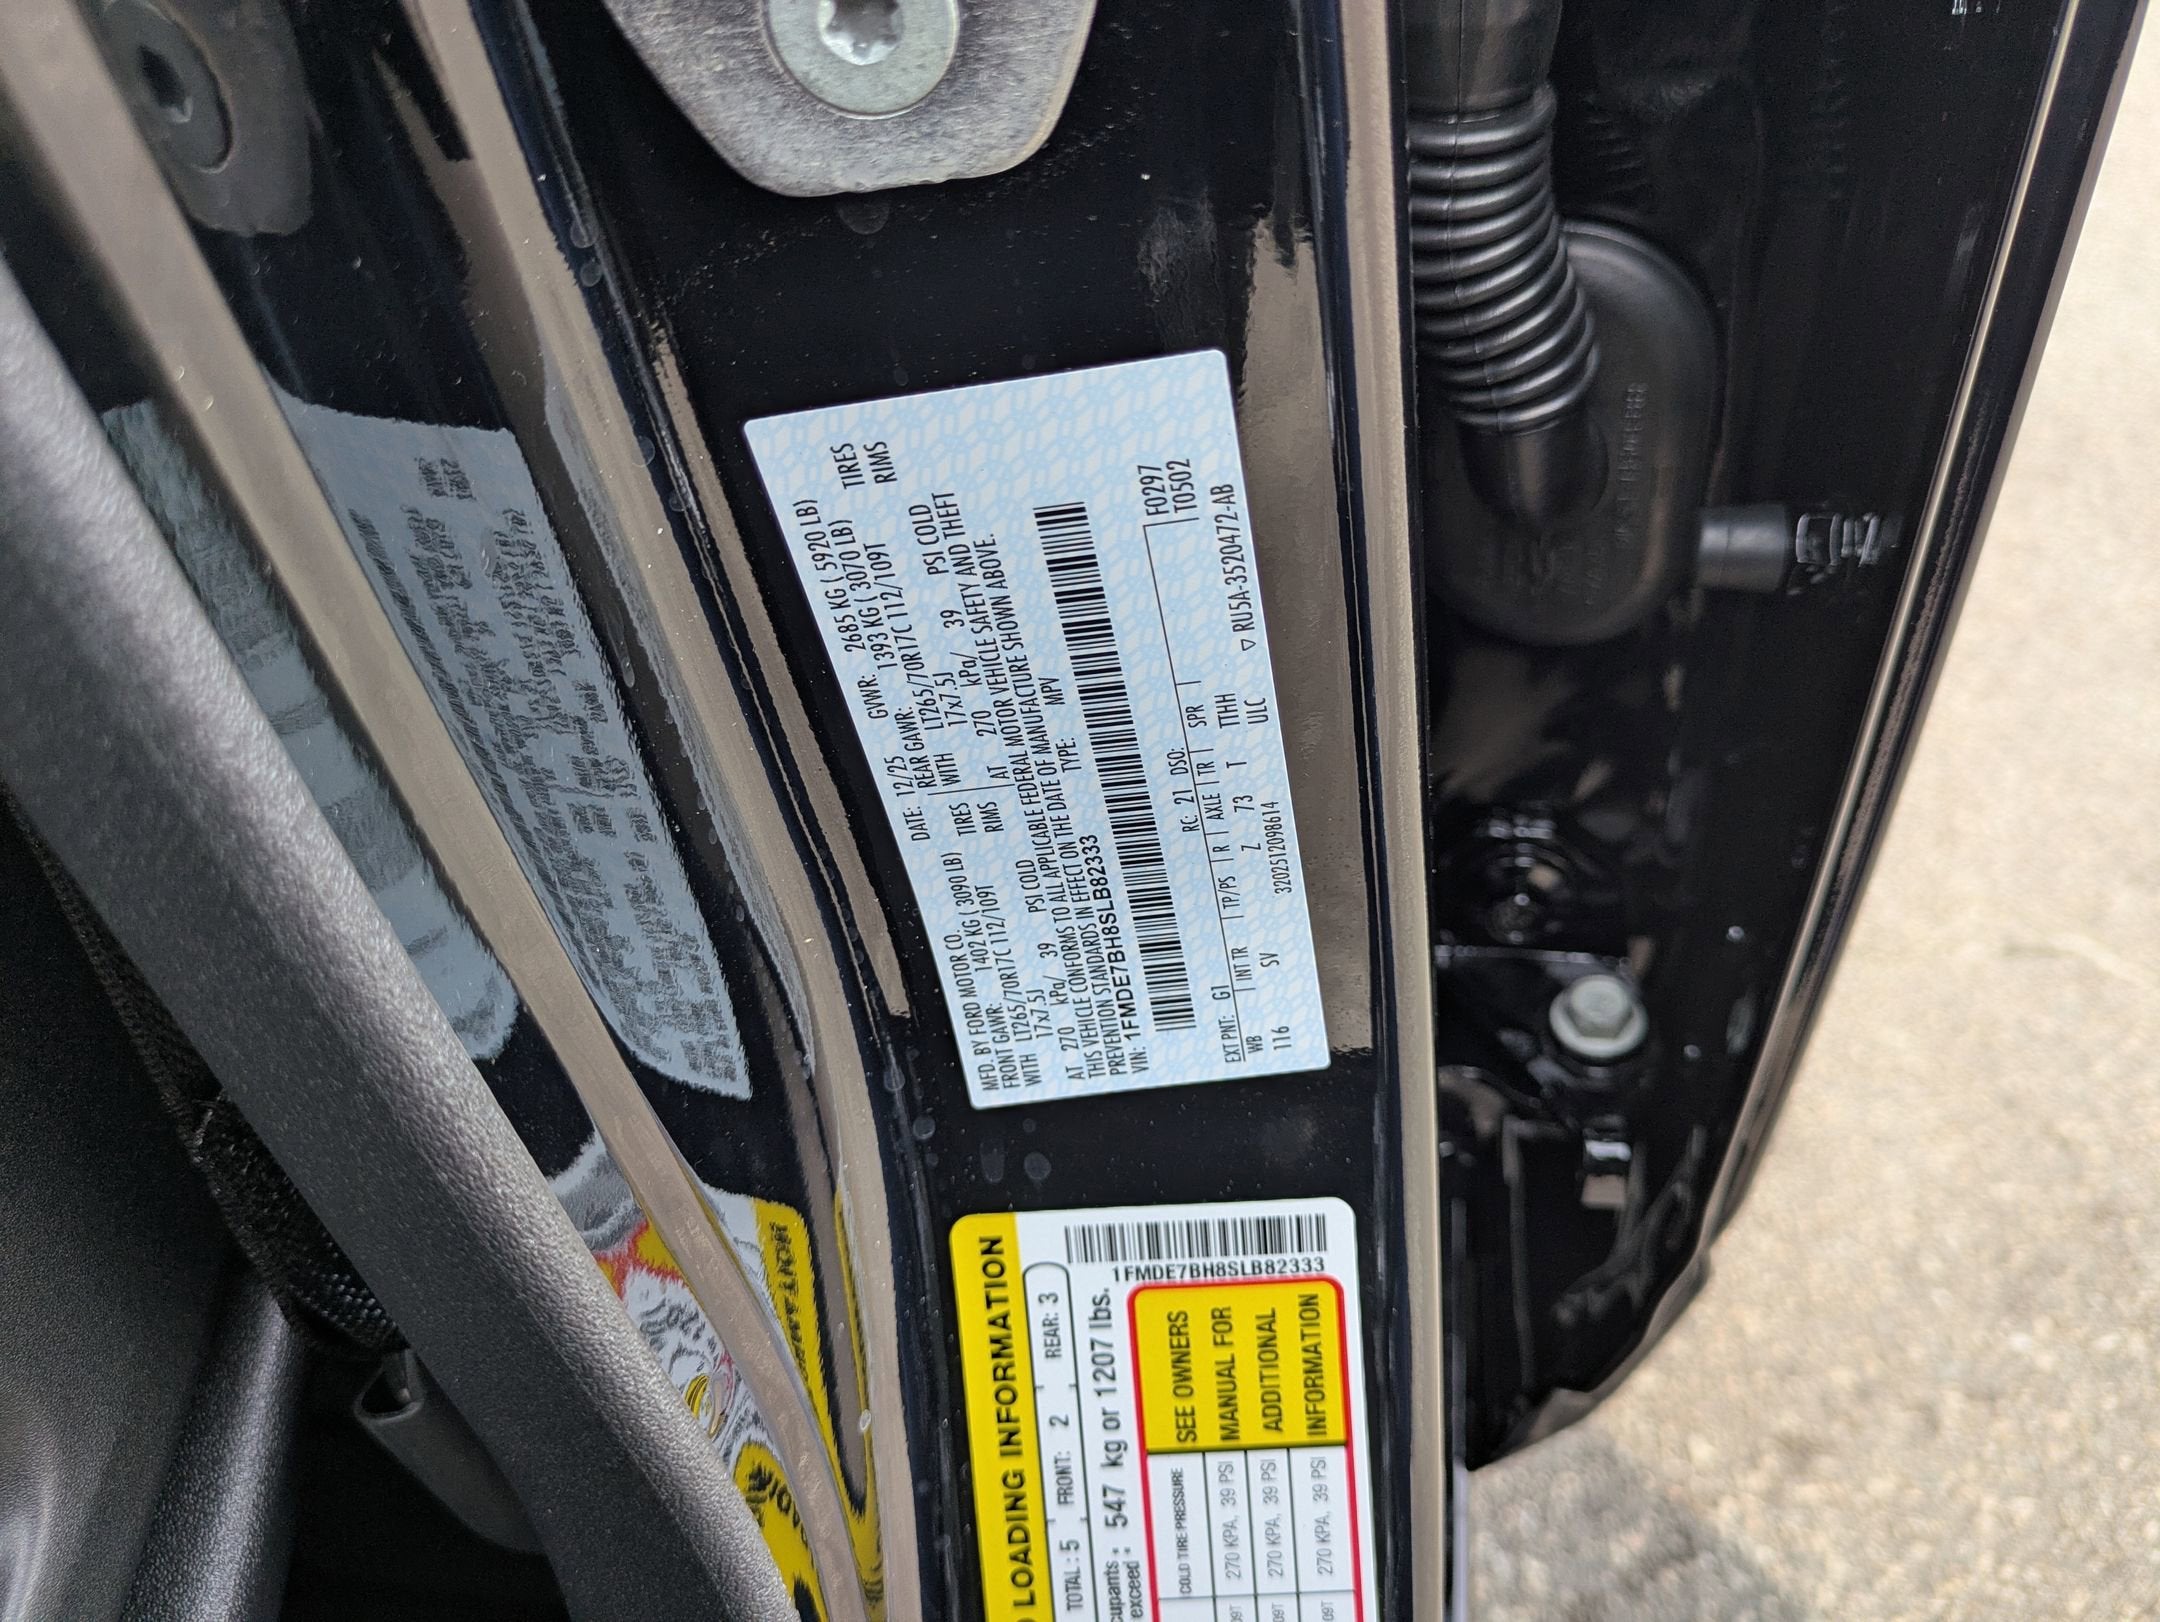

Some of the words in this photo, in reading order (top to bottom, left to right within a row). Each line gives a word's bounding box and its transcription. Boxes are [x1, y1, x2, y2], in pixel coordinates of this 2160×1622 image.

[829, 442, 866, 490] TIRES
[862, 441, 898, 484] RIMS
[1136, 464, 1170, 516] F0297
[1165, 458, 1198, 514] T0502
[792, 499, 822, 526] LB)
[907, 504, 940, 546] COLD
[930, 492, 966, 540] THEFT
[826, 519, 856, 546] LB)
[803, 530, 838, 571] 5920
[921, 550, 950, 575] PSI
[947, 543, 978, 576] AND
[972, 533, 1008, 590] ABOVE.
[1209, 483, 1255, 632] RU5A-3520472-AB
[838, 550, 872, 592] 3070
[862, 543, 908, 620] 112/109T
[824, 588, 851, 610] KG
[957, 582, 993, 634] SAFETY
[833, 613, 867, 653] 2685
[857, 606, 884, 629] KG
[939, 609, 965, 629] 39
[988, 594, 1024, 651] SHOWN
[866, 632, 898, 670] 1393
[974, 637, 1010, 696] VEHICLE
[889, 623, 945, 732] LT265/70R17C
[949, 651, 983, 687] kPa/
[856, 673, 889, 719] GVWR:
[931, 671, 968, 727] 17x7.5J
[1005, 654, 1053, 755] MANUFACTURE
[1037, 677, 1066, 706] MPV
[970, 709, 998, 737] 270
[992, 697, 1026, 747] MOTOR
[1184, 704, 1207, 728] SPR
[1213, 692, 1241, 729] TTHH
[1243, 697, 1269, 725] ULC
[893, 706, 925, 752] GAWR:
[908, 754, 938, 789] REAR
[932, 752, 962, 786] WITH
[1033, 759, 1058, 776] OF
[1054, 737, 1082, 773] TYPE:
[1195, 760, 1216, 777] TR
[1225, 761, 1247, 769] T
[883, 755, 916, 797] 12/25
[986, 765, 1010, 779] AT
[1007, 749, 1041, 806] FEDERAL
[1039, 778, 1067, 812] DATE
[1171, 789, 1195, 805] 21
[1201, 792, 1225, 820] AXLE
[1231, 794, 1255, 813] 73
[902, 805, 931, 841] DATE:
[948, 802, 977, 837] TIRES
[976, 801, 1004, 833] RIMS
[1048, 814, 1074, 839] THE
[1179, 814, 1200, 832] RC:
[1023, 808, 1062, 879] APPLICABLE
[1056, 840, 1079, 859] ON
[1211, 844, 1231, 853] R
[1240, 842, 1262, 852] Z
[1259, 801, 1292, 894] 3202512098614
[940, 852, 965, 872] LB)
[1014, 859, 1041, 891] COLD
[947, 875, 975, 907] 3090
[1044, 881, 1068, 903] ALL
[1061, 863, 1091, 903] EFFECT
[1217, 875, 1241, 910] TP/PS
[973, 885, 1009, 945] 112/109T
[1024, 893, 1047, 913] PSI
[1050, 906, 1072, 924] TO
[1073, 906, 1095, 920] IN
[943, 929, 964, 951] CO.
[961, 919, 984, 937] KG
[1078, 834, 1141, 1041] 1FMDE7BH8SLB82333
[967, 939, 993, 972] 1402
[1036, 942, 1058, 959] 39
[1055, 925, 1088, 993] CONFORMS
[1077, 922, 1112, 996] STANDARDS
[1230, 946, 1249, 961] TR
[1258, 952, 1280, 968] SV
[948, 953, 978, 998] MOTOR
[1232, 963, 1252, 981] INT
[987, 948, 1038, 1042] LT265/70R17C
[1042, 975, 1069, 1006] kPa/
[1210, 984, 1231, 1001] G1
[962, 1001, 987, 1036] FORD
[984, 1002, 1010, 1044] GAWR:
[1024, 988, 1054, 1039] 17x7.5J
[1072, 996, 1100, 1047] VEHICLE
[1217, 1014, 1238, 1040] PNT:
[970, 1040, 992, 1056] BY
[1056, 1026, 1079, 1052] 270
[1095, 998, 1128, 1076] PREVENTION
[1222, 1042, 1244, 1063] EXT
[1245, 1035, 1263, 1054] WB
[1270, 1025, 1292, 1050] 116
[977, 1059, 999, 1091] MFD.
[994, 1048, 1021, 1089] FRONT
[1018, 1053, 1042, 1087] WITH
[1065, 1066, 1085, 1080] AT
[1083, 1050, 1106, 1078] THIS
[1128, 1046, 1149, 1073] VIN:
[1112, 1257, 1326, 1282] 1FMDE7BH8SLB82333
[1038, 1293, 1058, 1304] 3
[1088, 1288, 1112, 1330] lbs.
[1042, 1313, 1062, 1358] REAR:
[1210, 1307, 1233, 1347] FOR
[980, 1235, 1023, 1457] INFORMATION
[1167, 1311, 1194, 1398] OWNERS
[1089, 1337, 1118, 1397] 1207
[1255, 1308, 1283, 1432] ADDITIONAL
[1298, 1294, 1327, 1436] INFORMATION
[1214, 1354, 1240, 1441] MANUAL
[1049, 1415, 1069, 1428] 2
[1099, 1408, 1120, 1430] or
[1175, 1406, 1197, 1442] SEE
[1098, 1441, 1127, 1467] kg
[1260, 1459, 1277, 1481] PSI
[1310, 1457, 1327, 1478] PSI
[1054, 1451, 1075, 1505] FRONT:
[1217, 1461, 1234, 1483] PSI
[1102, 1485, 1129, 1528] 547
[1171, 1468, 1187, 1529] PRESSURE
[1220, 1488, 1236, 1506] 39
[1262, 1486, 1279, 1504] 39
[1312, 1484, 1328, 1502] 39
[1001, 1470, 1037, 1606] LOADING
[1059, 1540, 1079, 1551] 5
[1176, 1532, 1189, 1559] TIRE
[1178, 1563, 1191, 1594] COLD
[1224, 1552, 1241, 1579] 270
[1267, 1551, 1283, 1577] 270
[1316, 1549, 1333, 1575] 270
[1122, 1561, 1143, 1618] exceed
